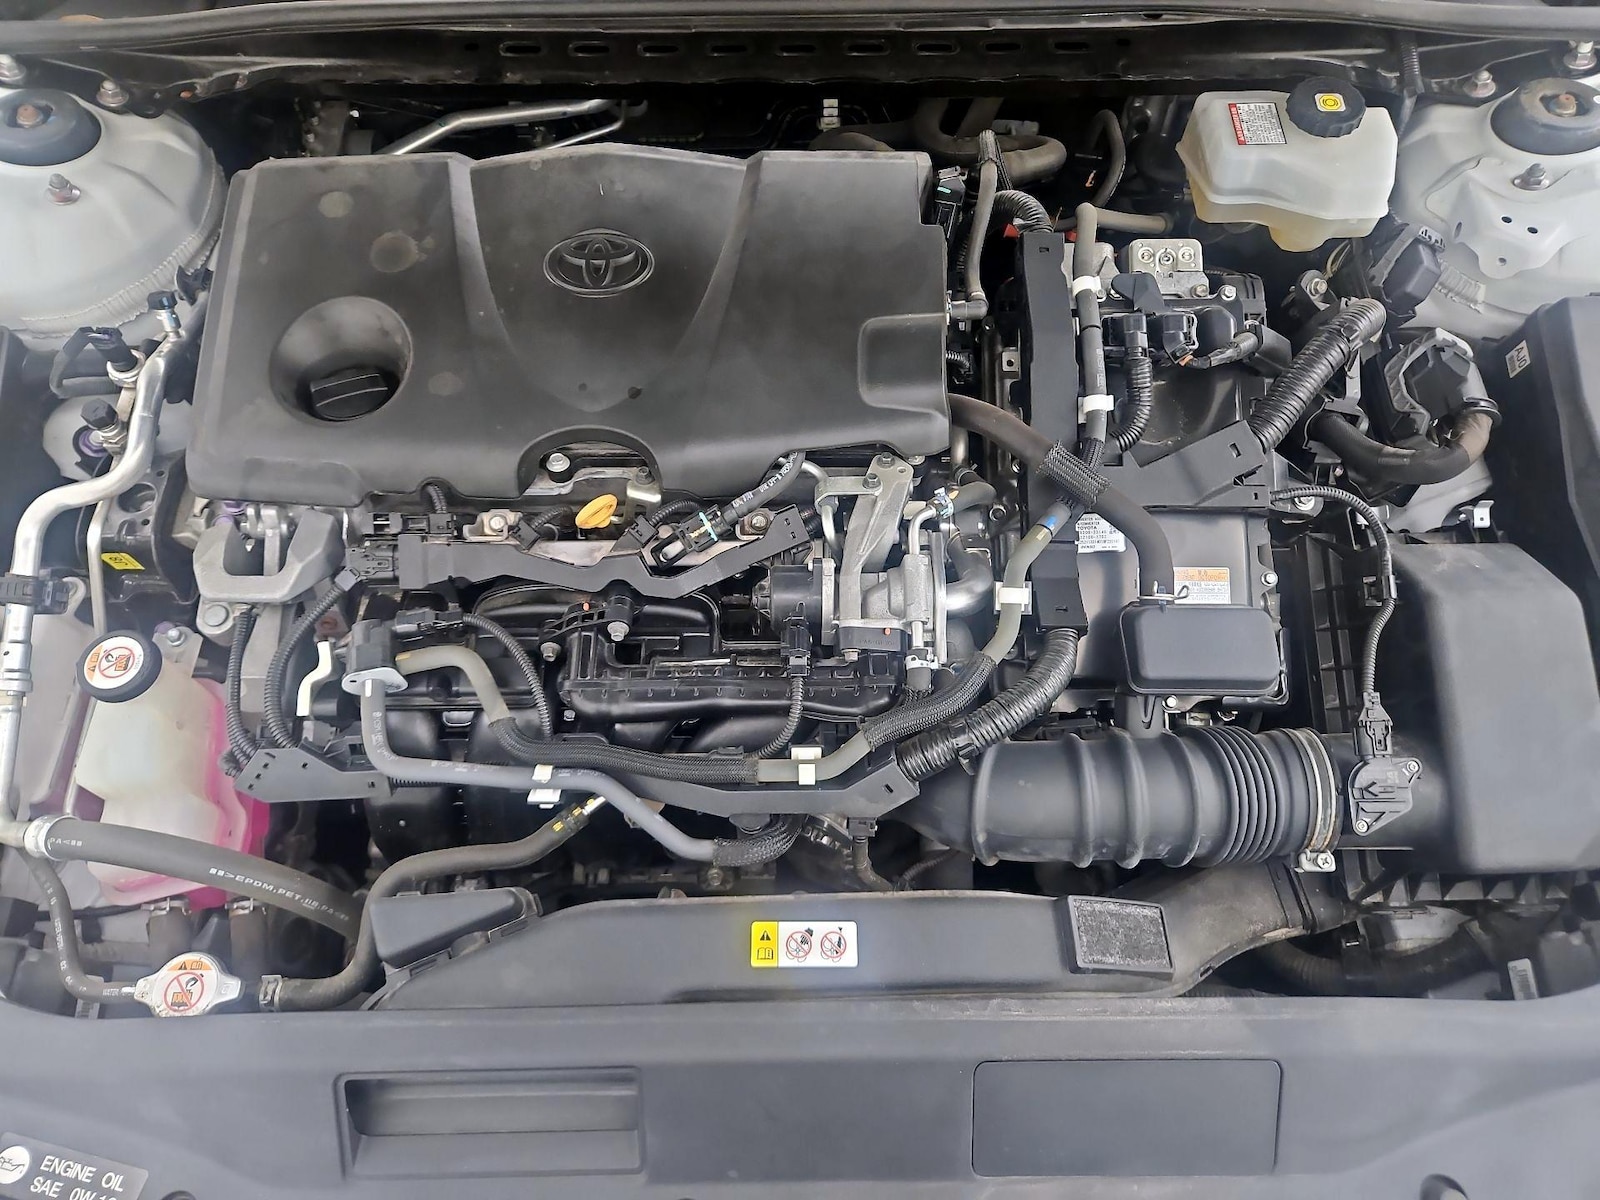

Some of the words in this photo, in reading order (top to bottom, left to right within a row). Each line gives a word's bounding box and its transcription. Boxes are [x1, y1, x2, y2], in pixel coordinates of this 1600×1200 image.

[30, 1176, 64, 1198] SAE
[40, 1155, 97, 1183] ENGINE
[101, 1172, 124, 1192] OIL
